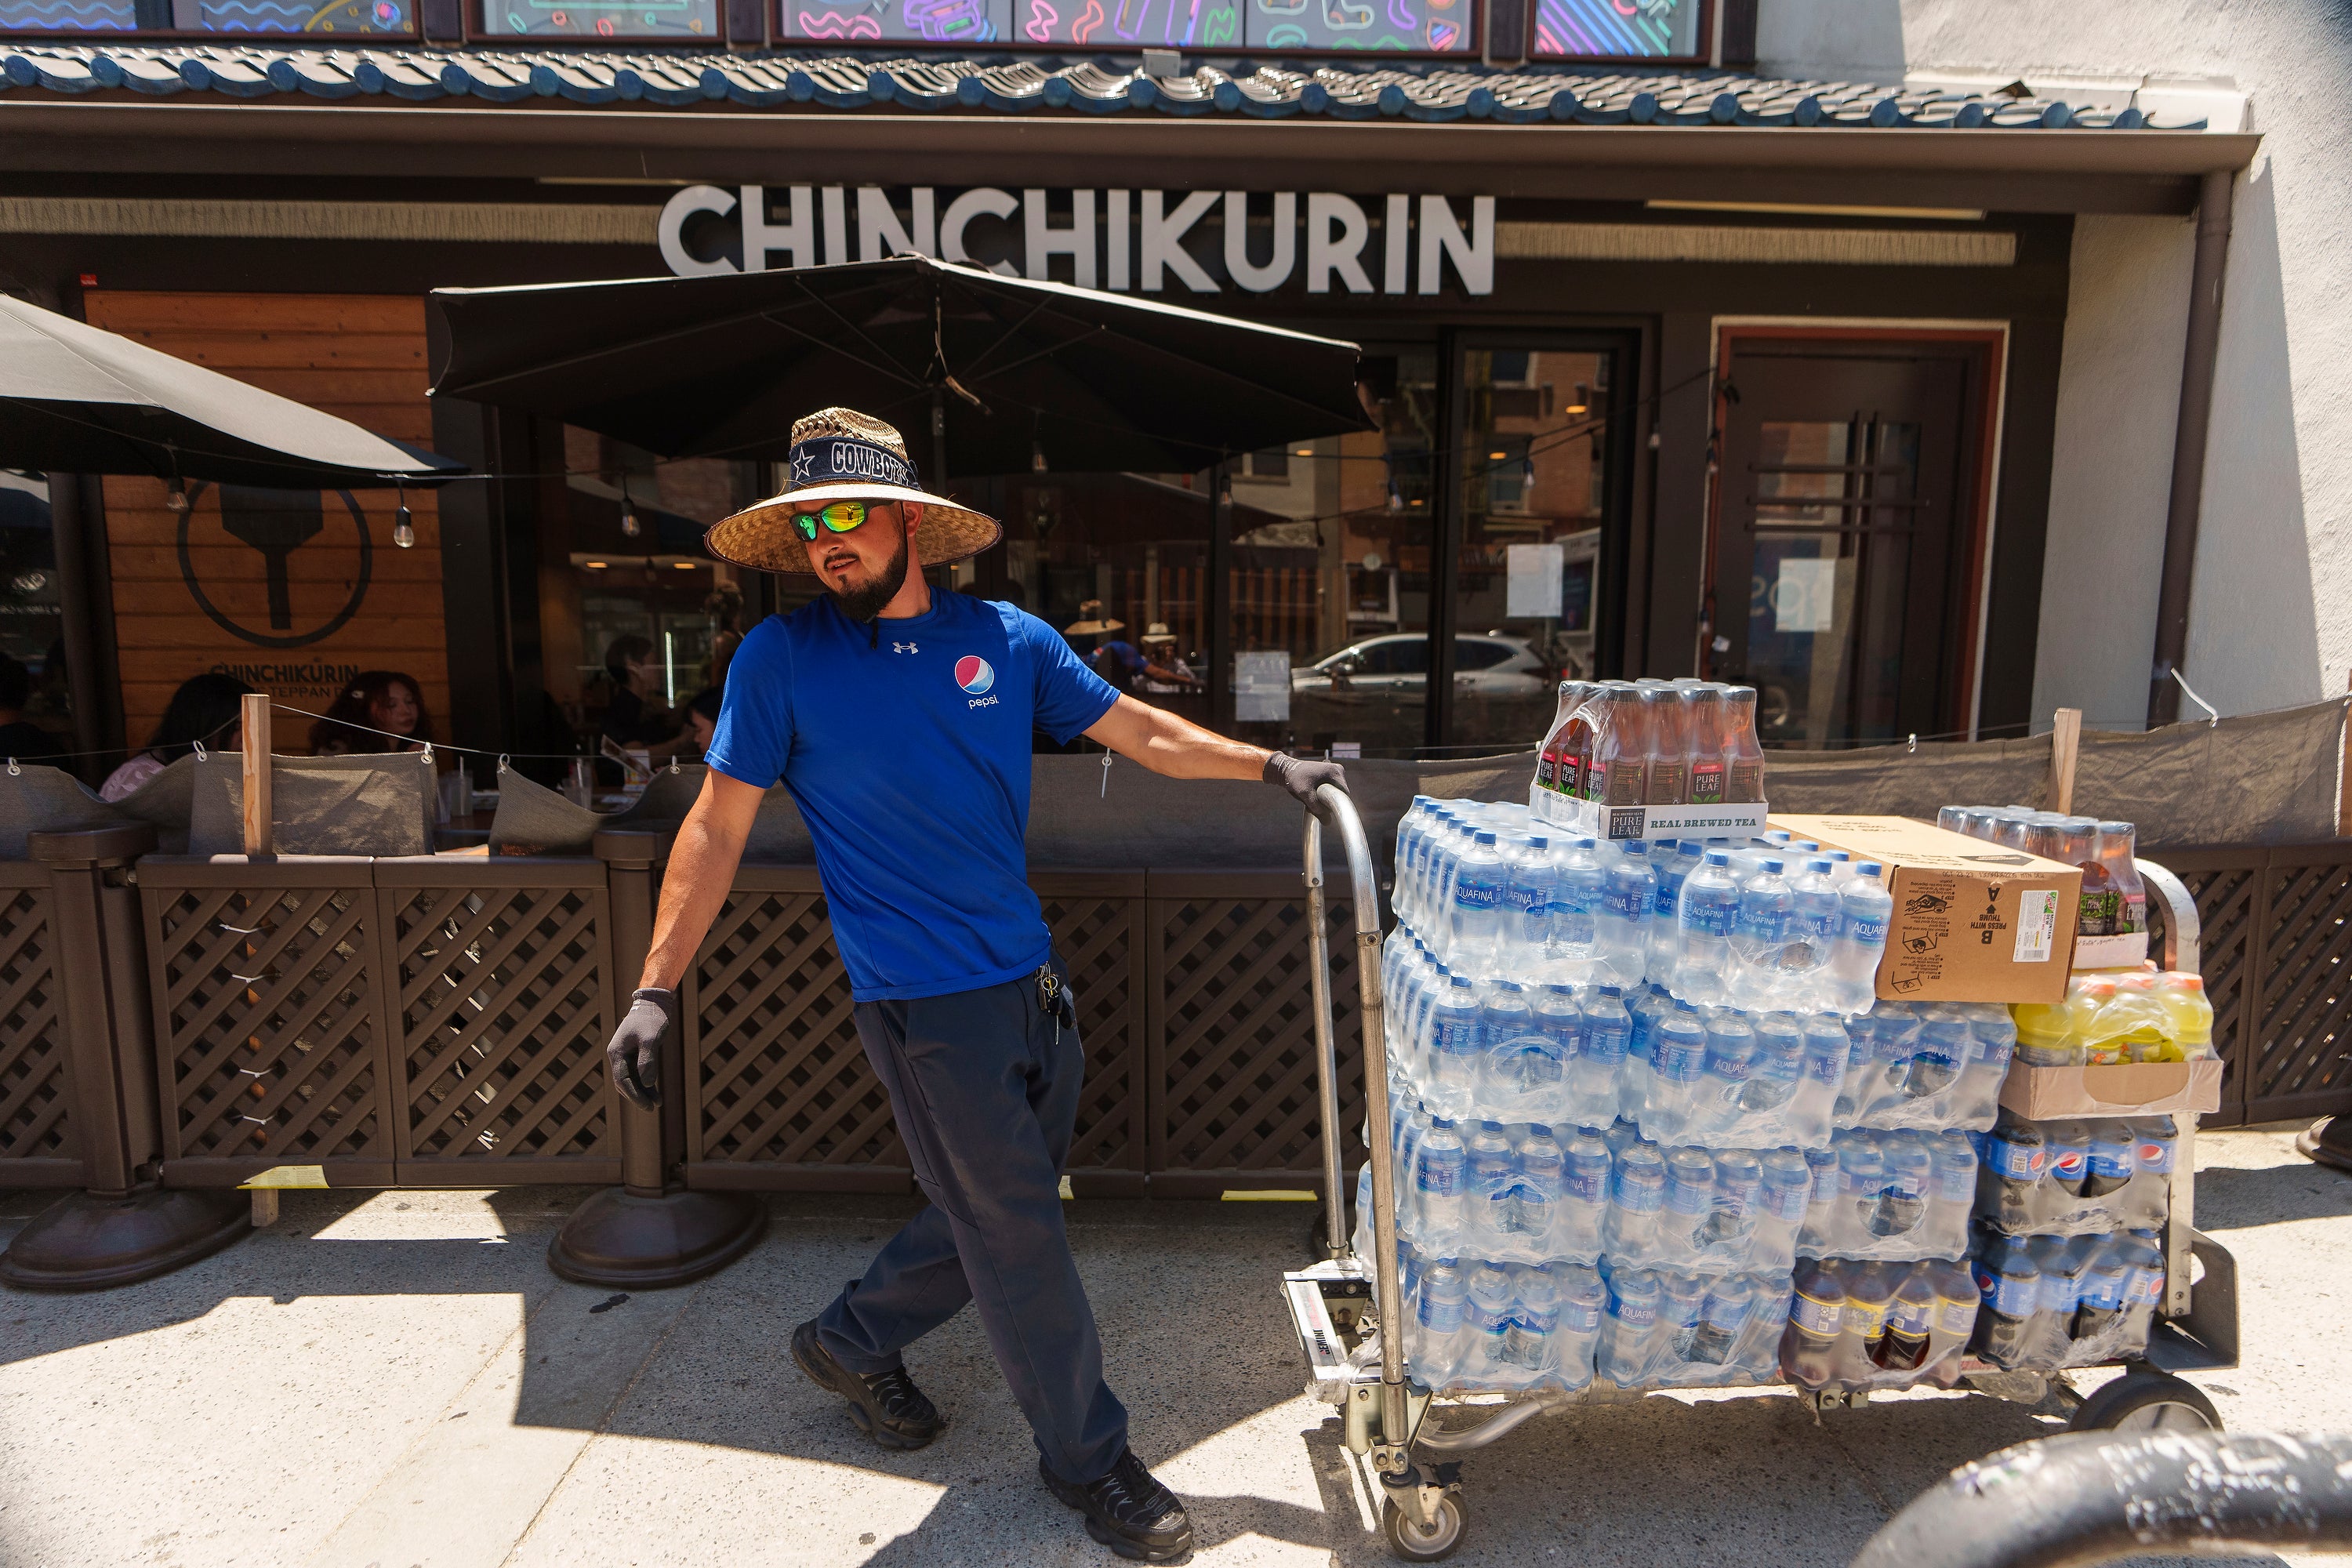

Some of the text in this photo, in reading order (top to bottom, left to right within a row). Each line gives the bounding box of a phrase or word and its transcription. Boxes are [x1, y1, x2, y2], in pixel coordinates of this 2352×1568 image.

[658, 185, 1494, 296] CHINCHIKURIN
[270, 687, 328, 698] TEPPAN
[968, 695, 998, 710] pepsi
[1541, 760, 1553, 771] PURE
[1563, 764, 1576, 776] PURE
[1540, 769, 1553, 779] LEAF
[1562, 773, 1575, 784] LEAF
[1697, 775, 1720, 783] PURE
[1696, 783, 1719, 792] LEAF
[1613, 817, 1642, 826] PURE
[1650, 820, 1681, 829] REAL
[1612, 826, 1638, 836] LEAF
[1505, 890, 1533, 906] UAFINA
[1987, 887, 2000, 902] A
[1692, 906, 1724, 919] AQUAFINA
[1743, 913, 1775, 927] AQUAFINA
[1981, 931, 1993, 945] B
[1996, 1283, 2006, 1306] pepsi
[1481, 1315, 1508, 1327] AQUAF
